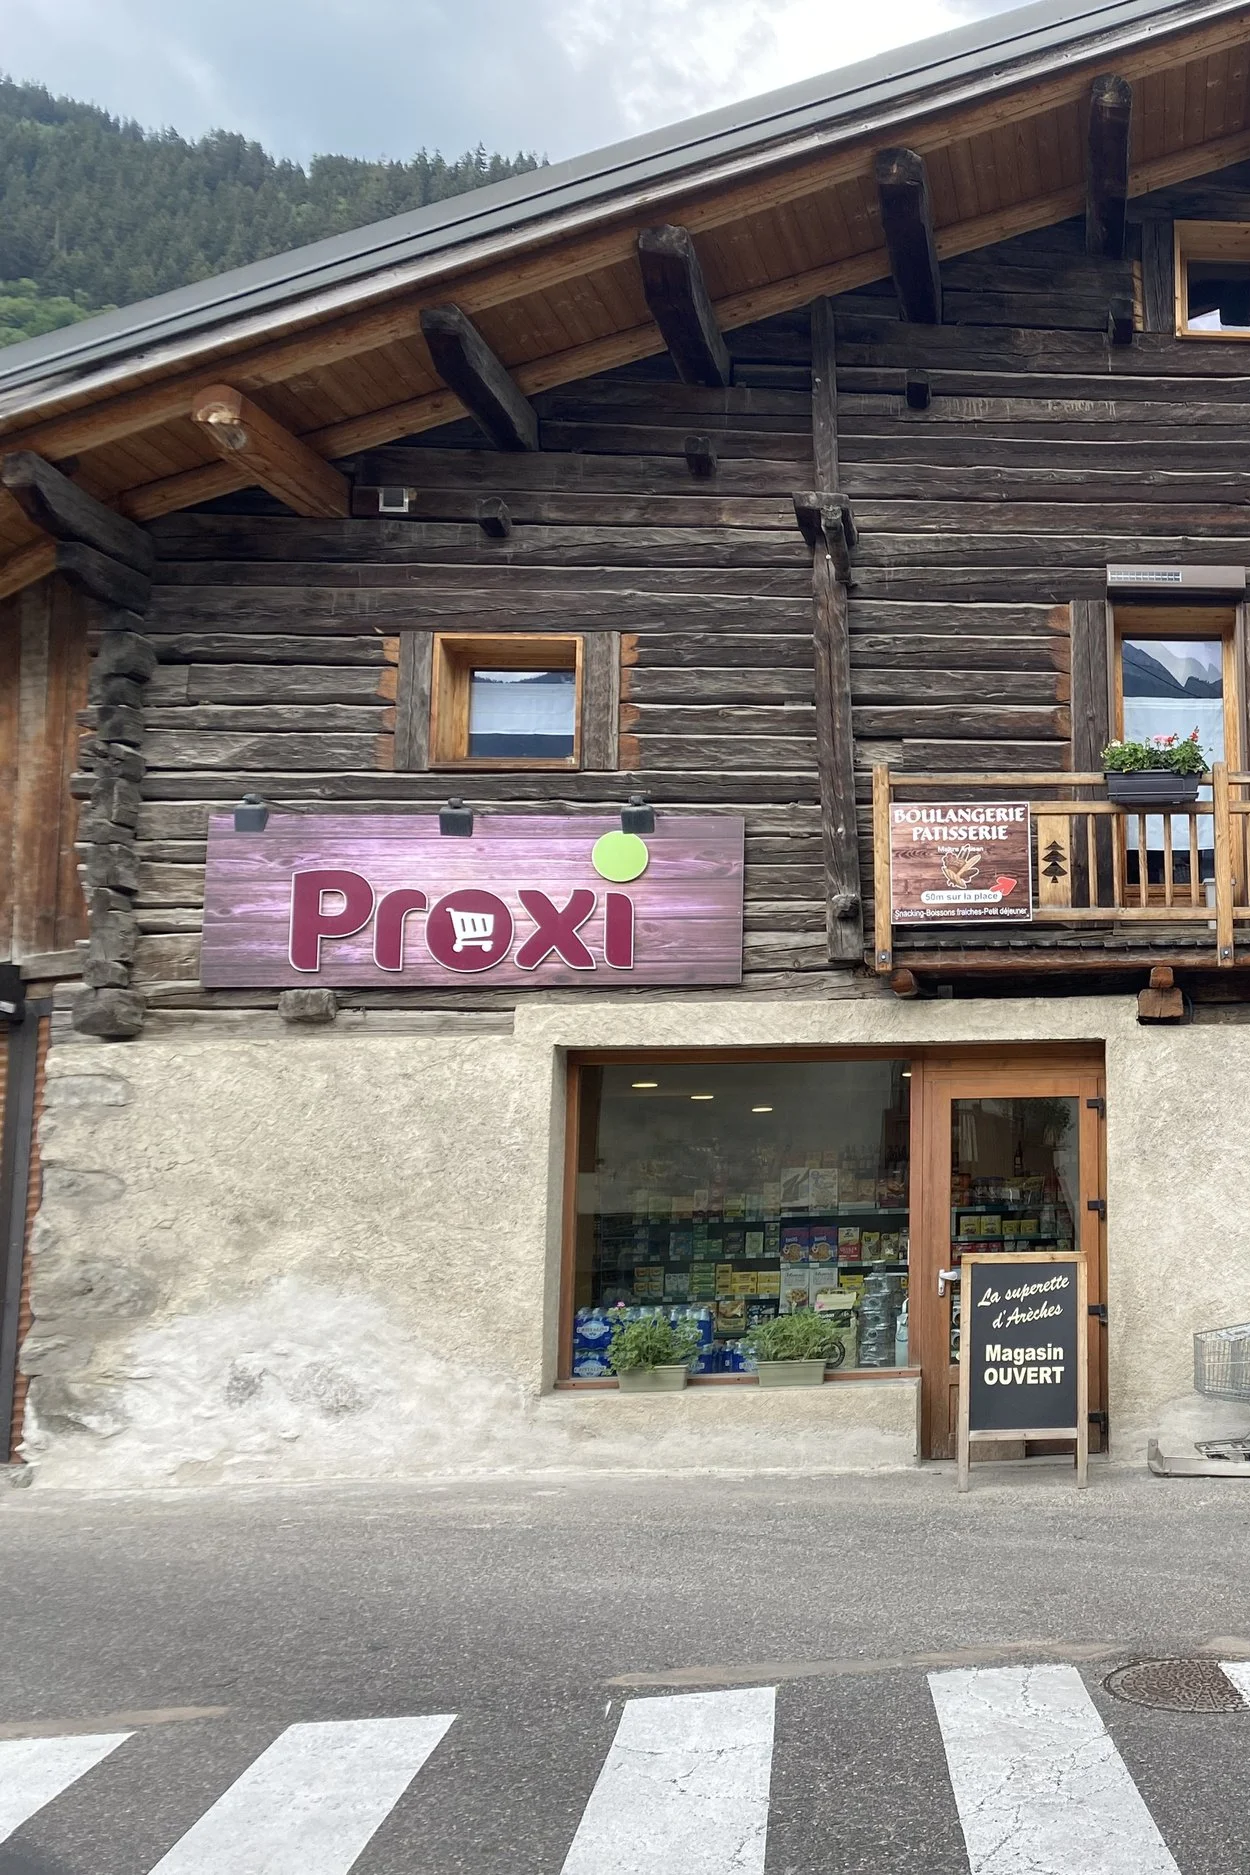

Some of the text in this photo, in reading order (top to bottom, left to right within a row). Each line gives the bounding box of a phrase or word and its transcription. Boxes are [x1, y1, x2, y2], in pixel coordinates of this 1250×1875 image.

[894, 807, 1026, 824] BOULANGERIE
[912, 825, 1008, 841] PATISSERIE
[289, 830, 648, 972] Proxi
[925, 893, 944, 901] 50m
[974, 892, 998, 902] place
[977, 1275, 1069, 1307] La superette
[992, 1301, 1063, 1328] d'Arèches
[986, 1344, 1064, 1365] Magasin
[984, 1367, 1064, 1385] OUVERT
